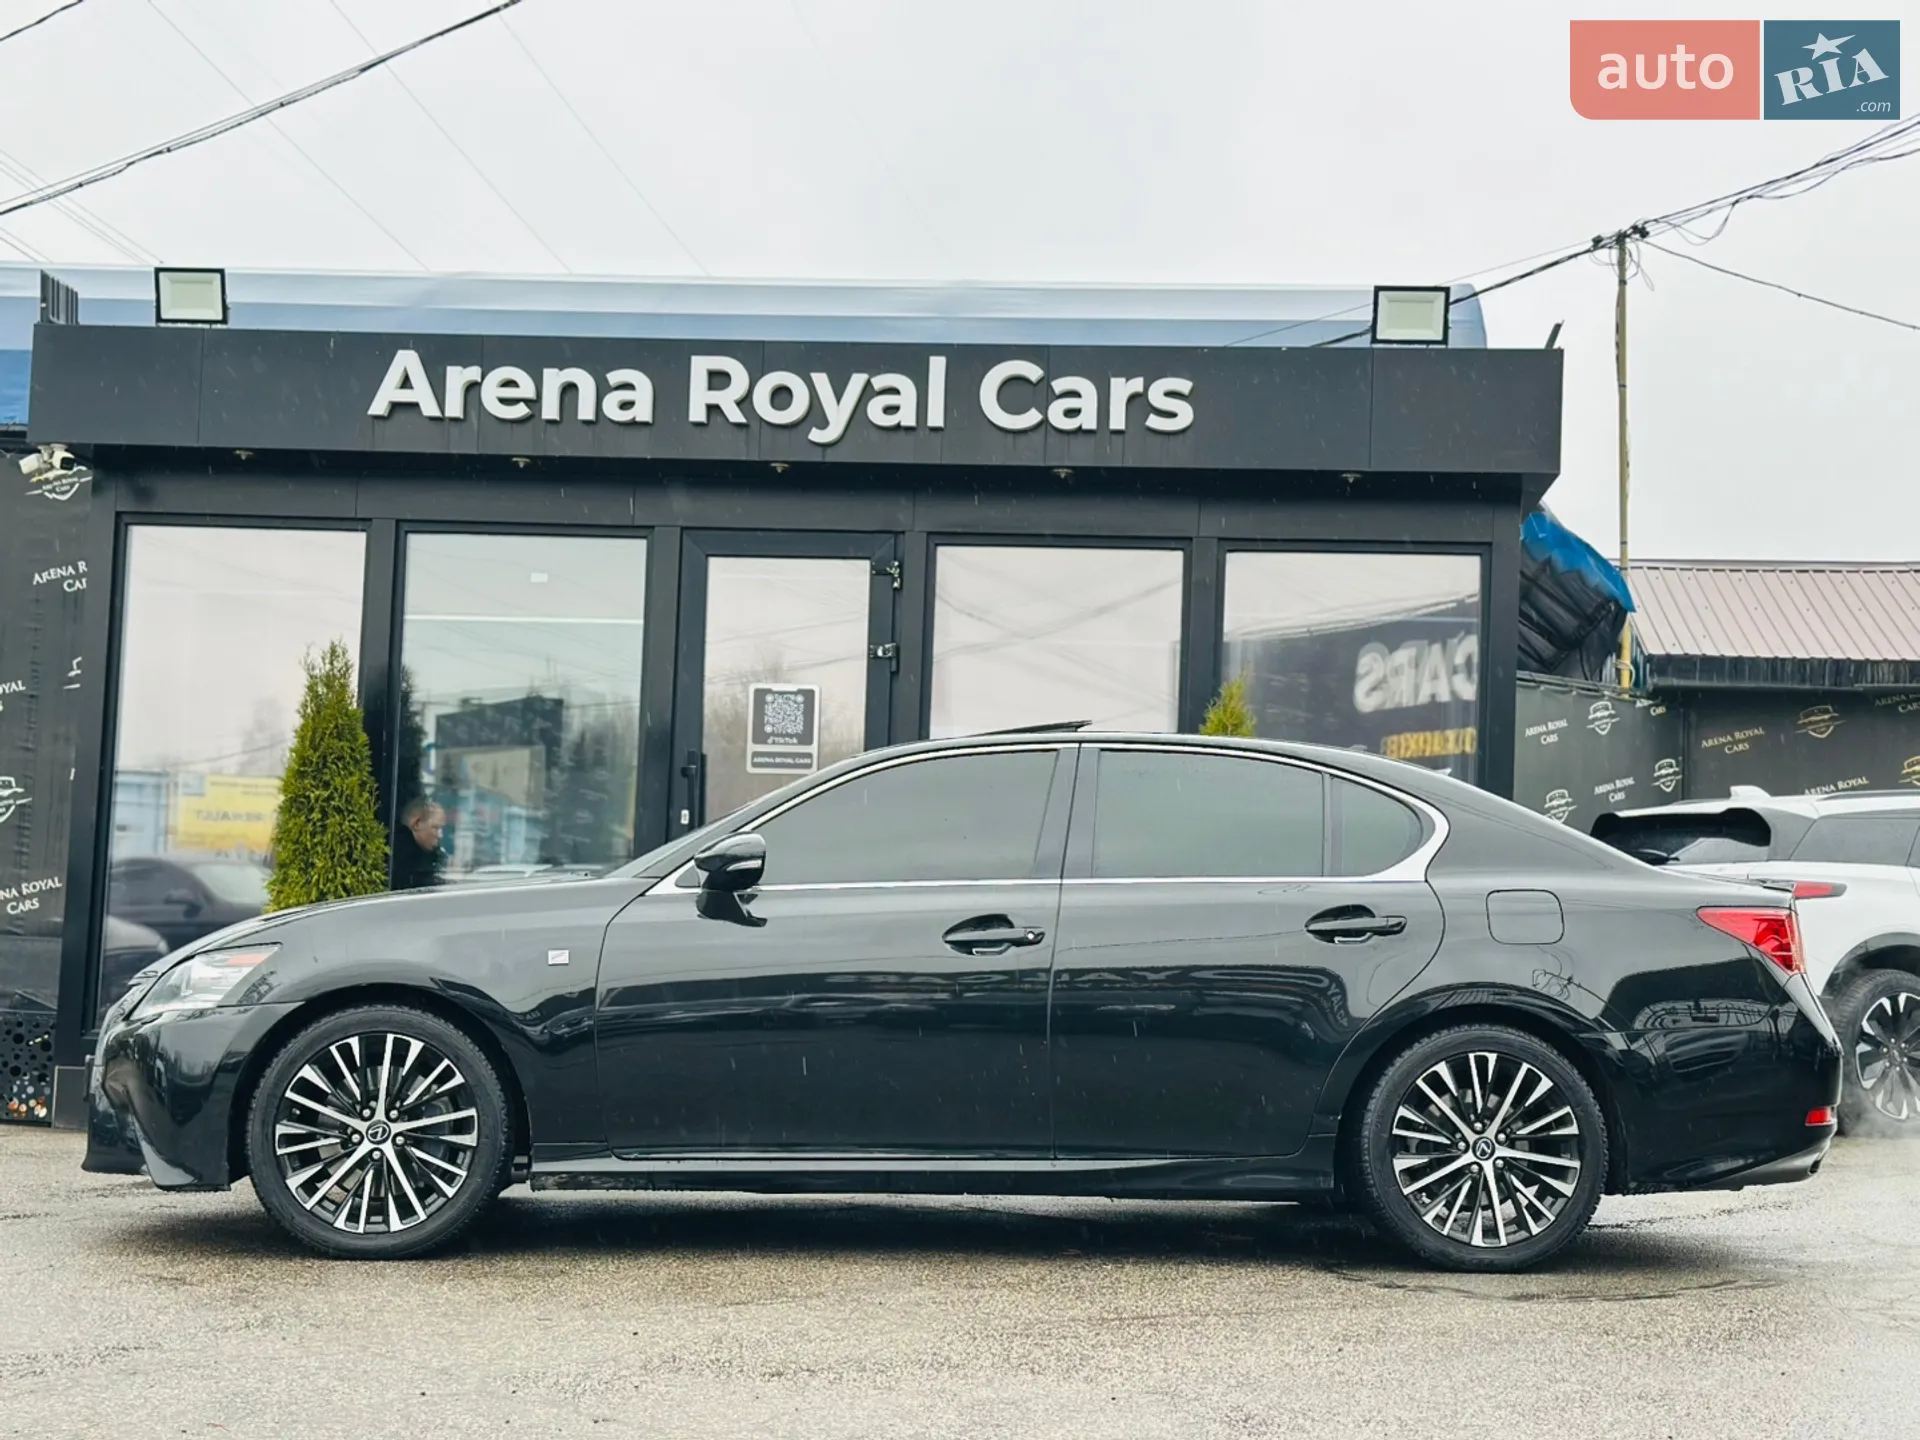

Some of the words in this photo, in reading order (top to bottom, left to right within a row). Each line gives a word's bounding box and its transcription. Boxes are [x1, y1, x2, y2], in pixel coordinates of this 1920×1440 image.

[366, 349, 655, 427] Arena
[687, 354, 948, 446] Royal
[978, 360, 1196, 434] Cars
[33, 565, 76, 586] ARENA
[1524, 724, 1547, 737] ARENA
[1547, 718, 1568, 732] ROYAL
[1540, 732, 1559, 745] CARS
[1701, 734, 1733, 749] ARENA
[1734, 726, 1765, 741] ROYAL
[1724, 741, 1750, 755] CARS
[1836, 776, 1870, 790] ROYAL
[21, 876, 63, 896] ROYAL
[6, 897, 40, 915] CARS
